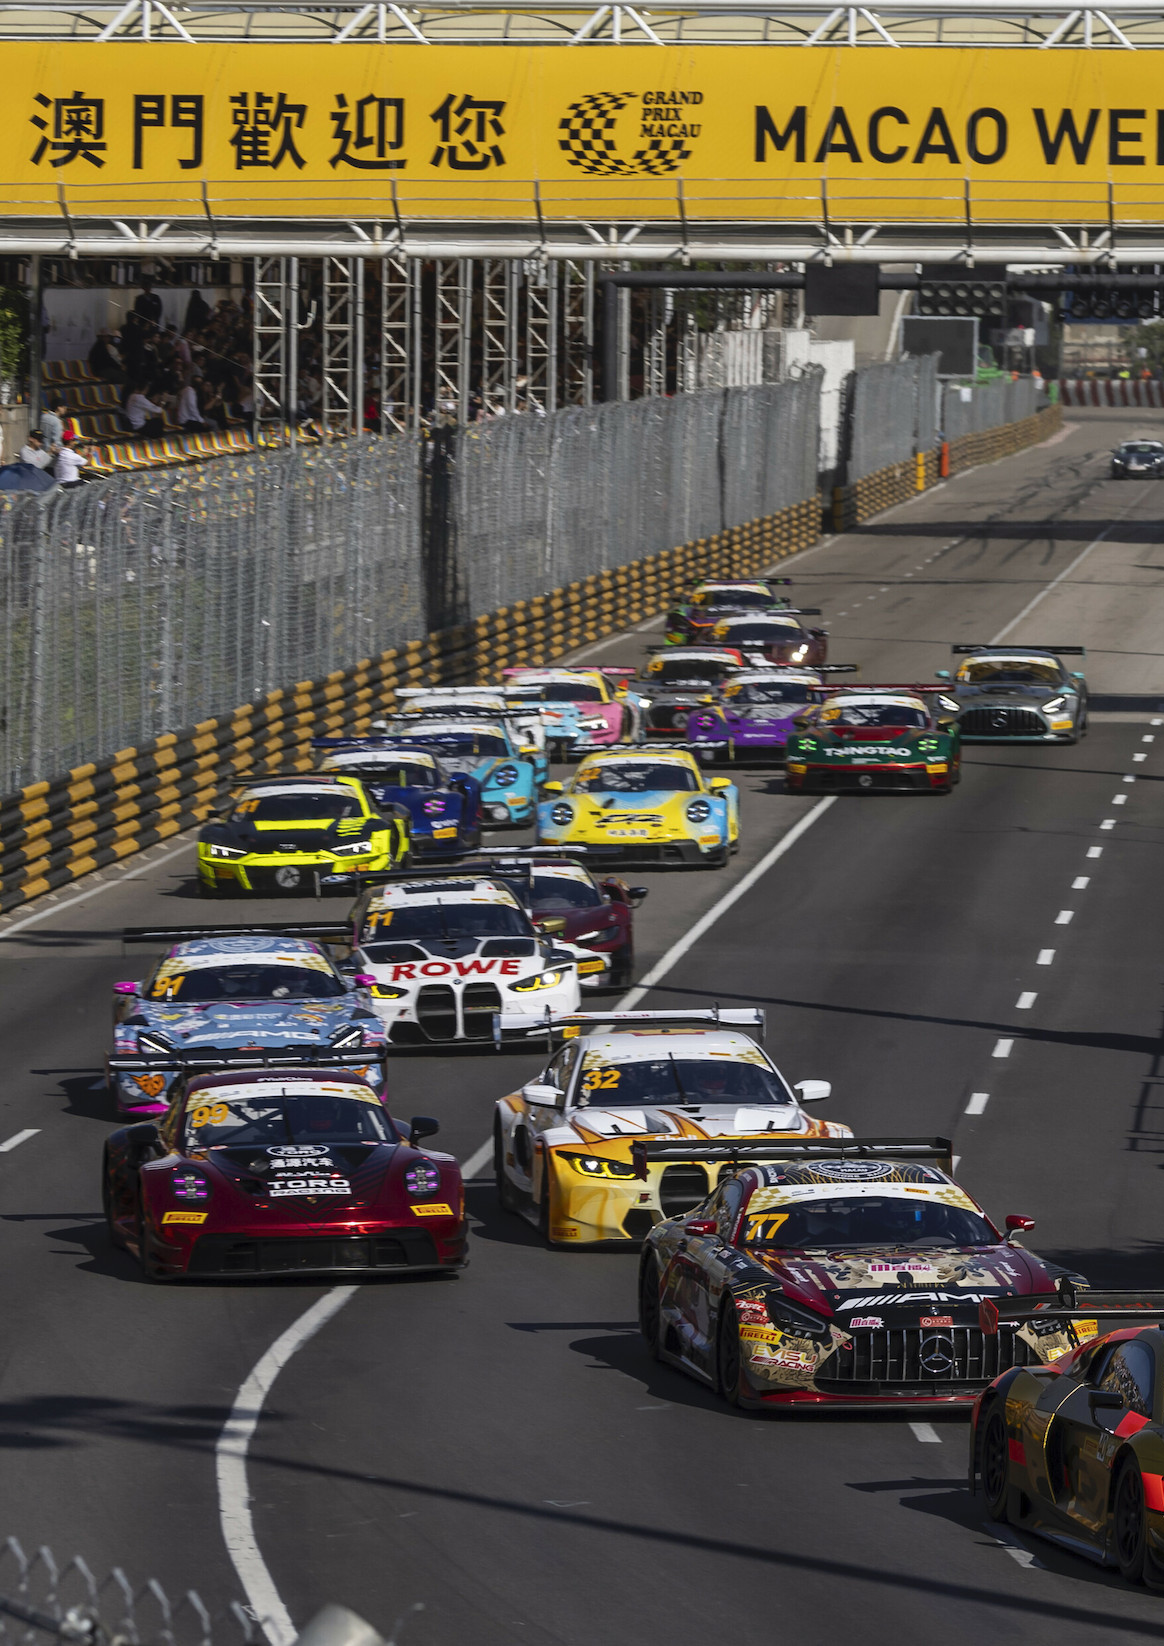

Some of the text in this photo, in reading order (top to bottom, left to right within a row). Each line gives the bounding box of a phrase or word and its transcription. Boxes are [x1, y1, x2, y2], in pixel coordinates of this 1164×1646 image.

[641, 90, 704, 105] GRAND
[640, 107, 684, 121] PRIX
[29, 90, 506, 171] 澳門歡迎您
[639, 123, 703, 138] MACAU
[754, 105, 1009, 165] MACAO
[823, 746, 912, 757] TSINGTAO
[366, 911, 394, 927] 11
[391, 959, 521, 982] ROWE
[151, 975, 186, 997] 91
[584, 1070, 622, 1091] 32
[192, 1103, 230, 1128] 99
[267, 1179, 351, 1189] TORO
[165, 1214, 205, 1223] PIRELLI
[745, 1213, 790, 1241] 77
[740, 1327, 778, 1342] PIRELLI
[752, 1344, 818, 1364] EVISU
[767, 1359, 815, 1372] RACING
